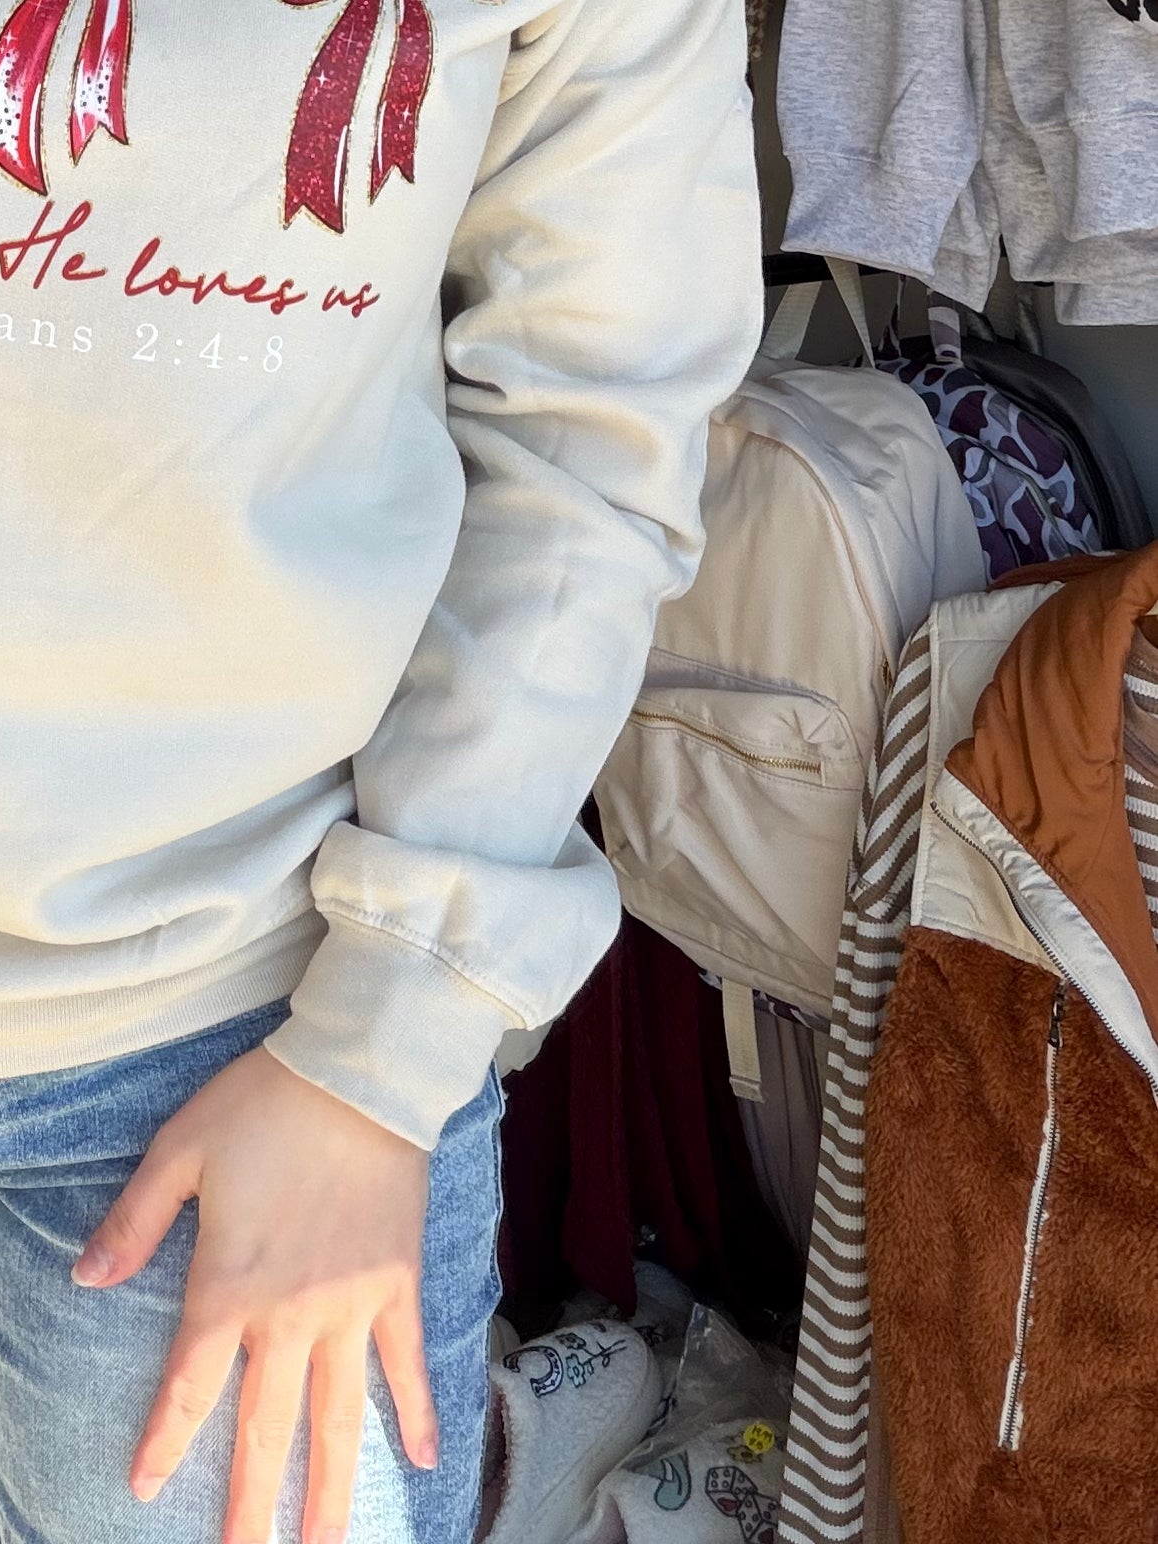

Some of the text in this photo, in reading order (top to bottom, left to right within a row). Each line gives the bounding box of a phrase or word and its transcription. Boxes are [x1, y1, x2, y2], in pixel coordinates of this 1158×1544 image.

[124, 238, 307, 315] loves
[322, 284, 381, 319] us
[131, 322, 285, 373] 2:4-8
